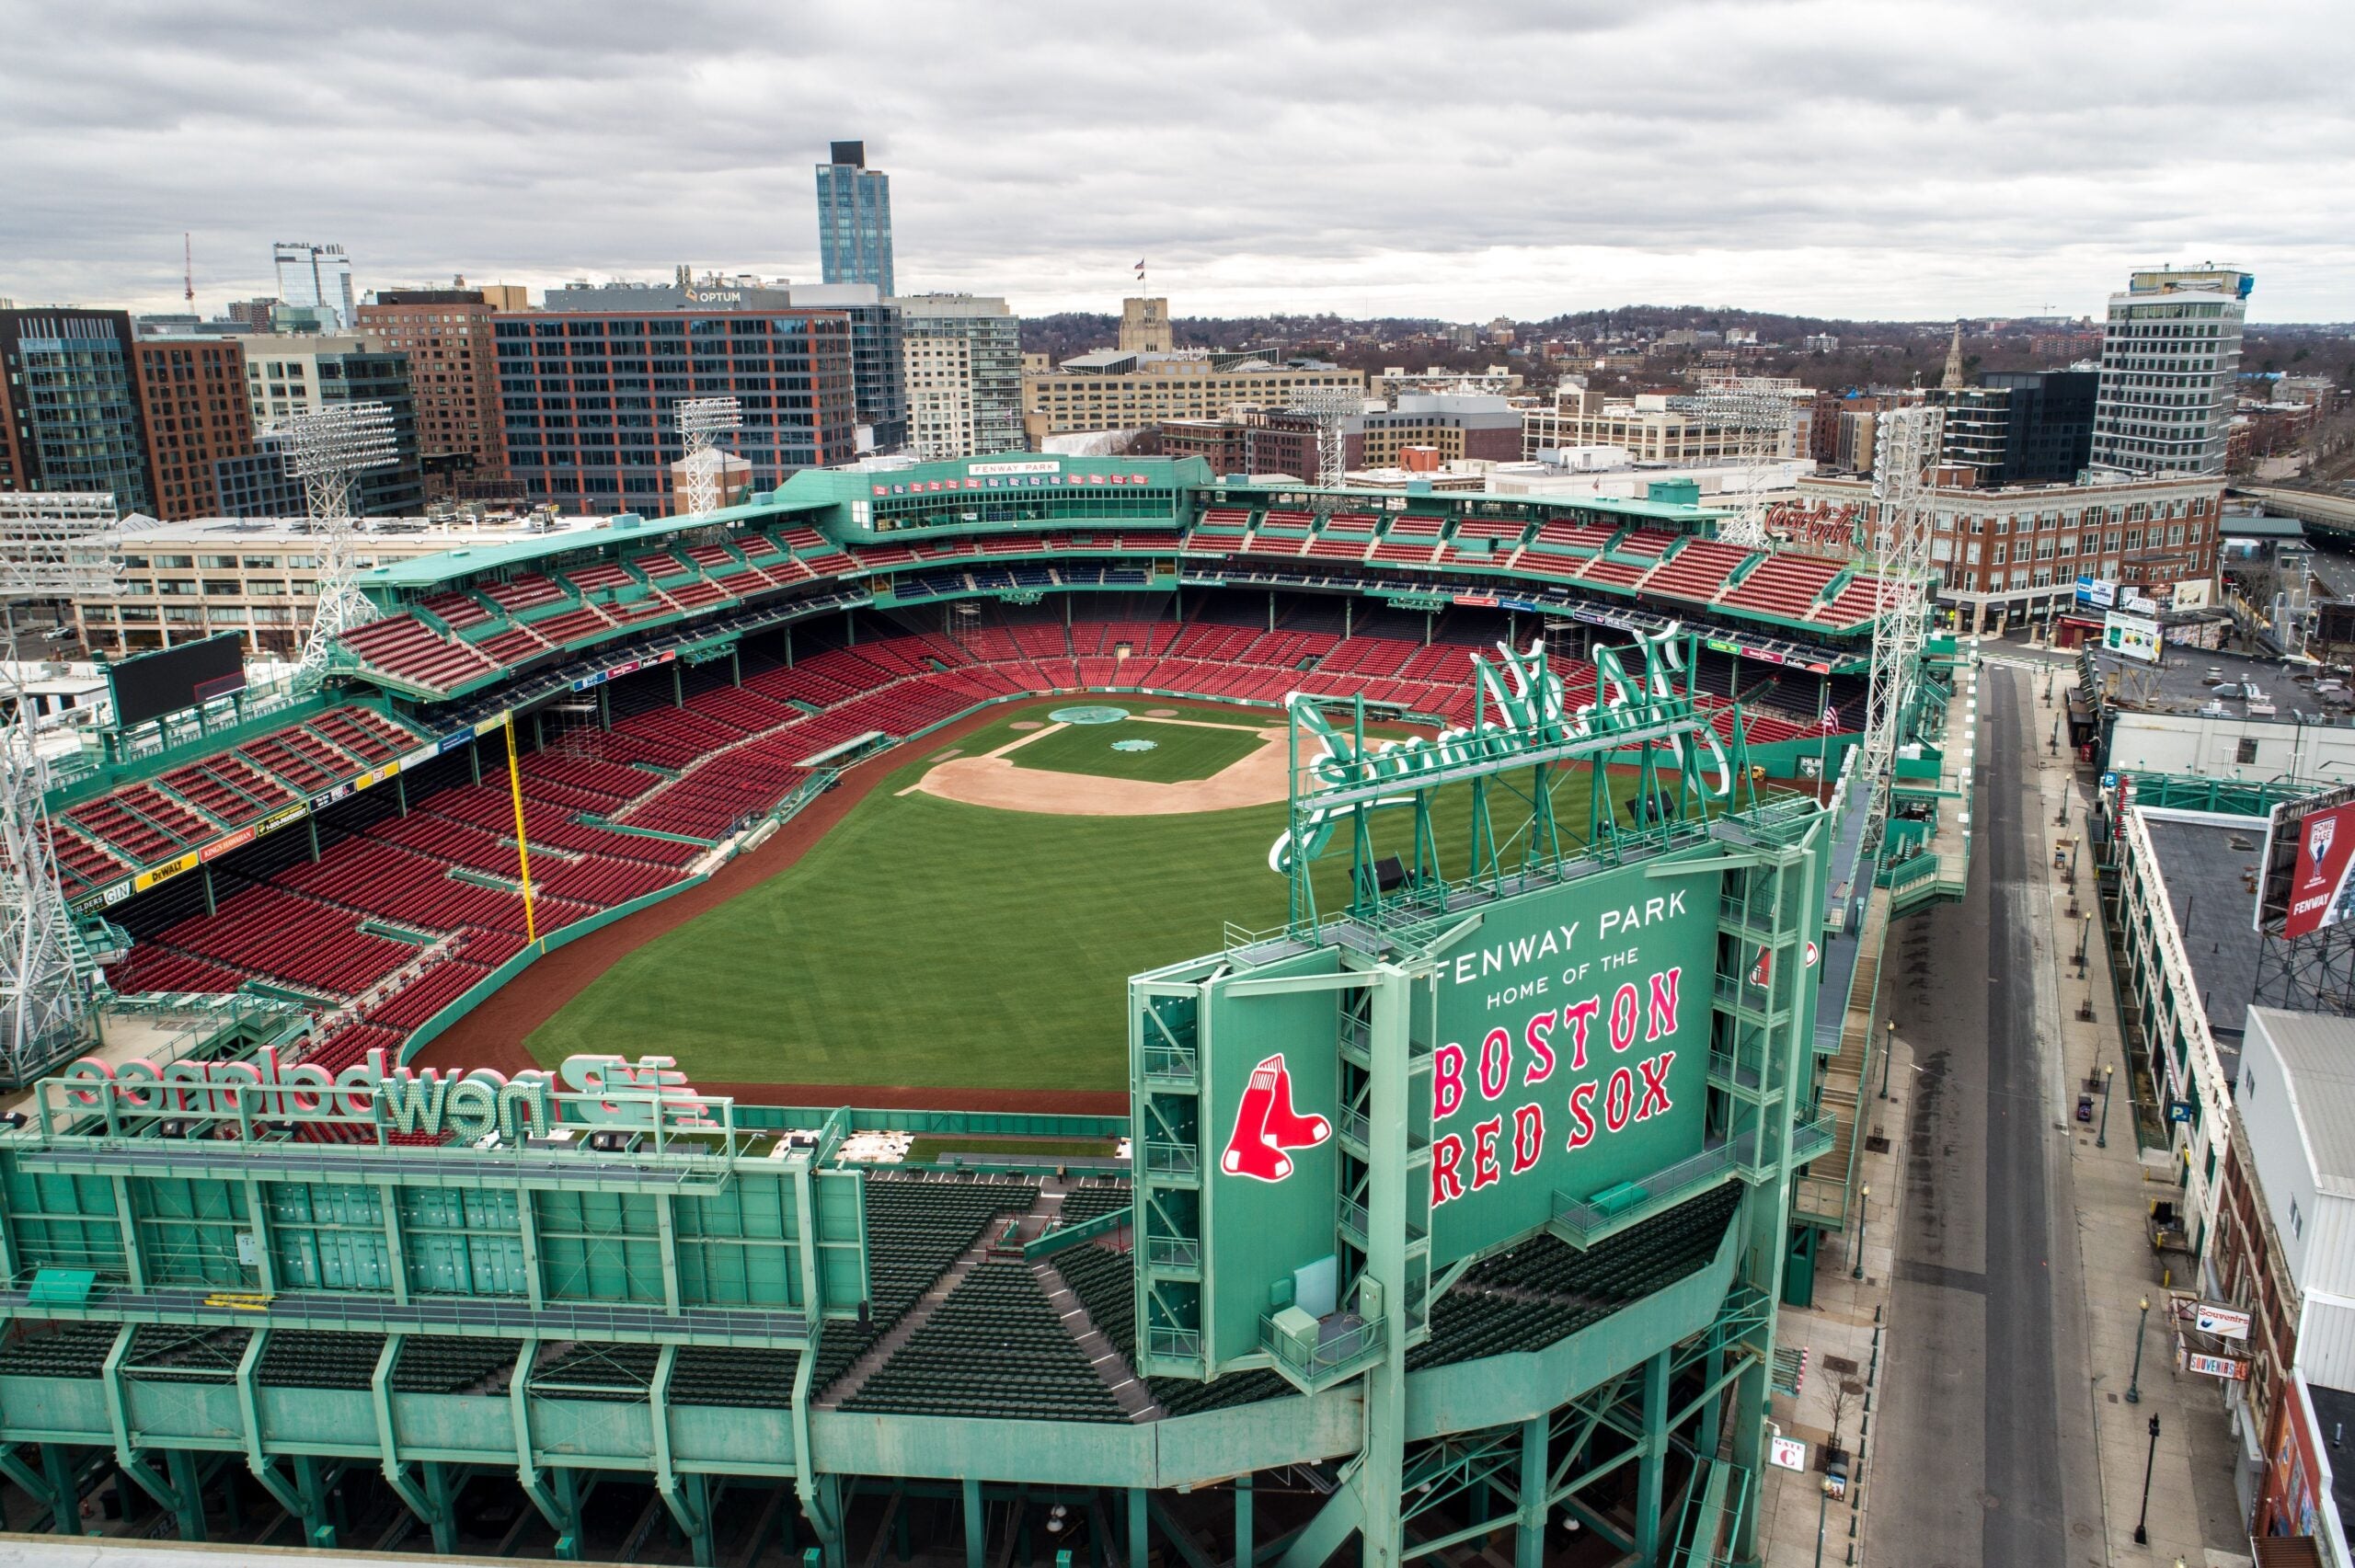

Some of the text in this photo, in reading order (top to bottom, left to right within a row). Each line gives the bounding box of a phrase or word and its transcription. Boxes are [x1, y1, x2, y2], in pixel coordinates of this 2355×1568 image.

[699, 292, 741, 303] OPTUM
[974, 463, 1054, 474] FENWAY PARK
[1764, 501, 1859, 543] Coca-Cola
[2106, 775, 2114, 784] P
[266, 807, 306, 831] 1-800-PAVEMENT
[2314, 820, 2334, 835] HOME
[2313, 830, 2331, 844] BASE
[106, 884, 129, 903] GIN
[2293, 892, 2330, 916] FENWAY
[1429, 888, 1689, 991] FENWAY PARK
[1486, 947, 1639, 1009] HOME OF THE
[1432, 966, 1683, 1121] BOSTON
[2172, 1106, 2184, 1118] P
[1430, 1050, 1677, 1210] RED SOX
[2199, 1307, 2249, 1325] Souvenirs
[2190, 1354, 2234, 1376] SOUVENIRS
[1775, 1439, 1804, 1450] GATE
[1780, 1449, 1796, 1466] C
